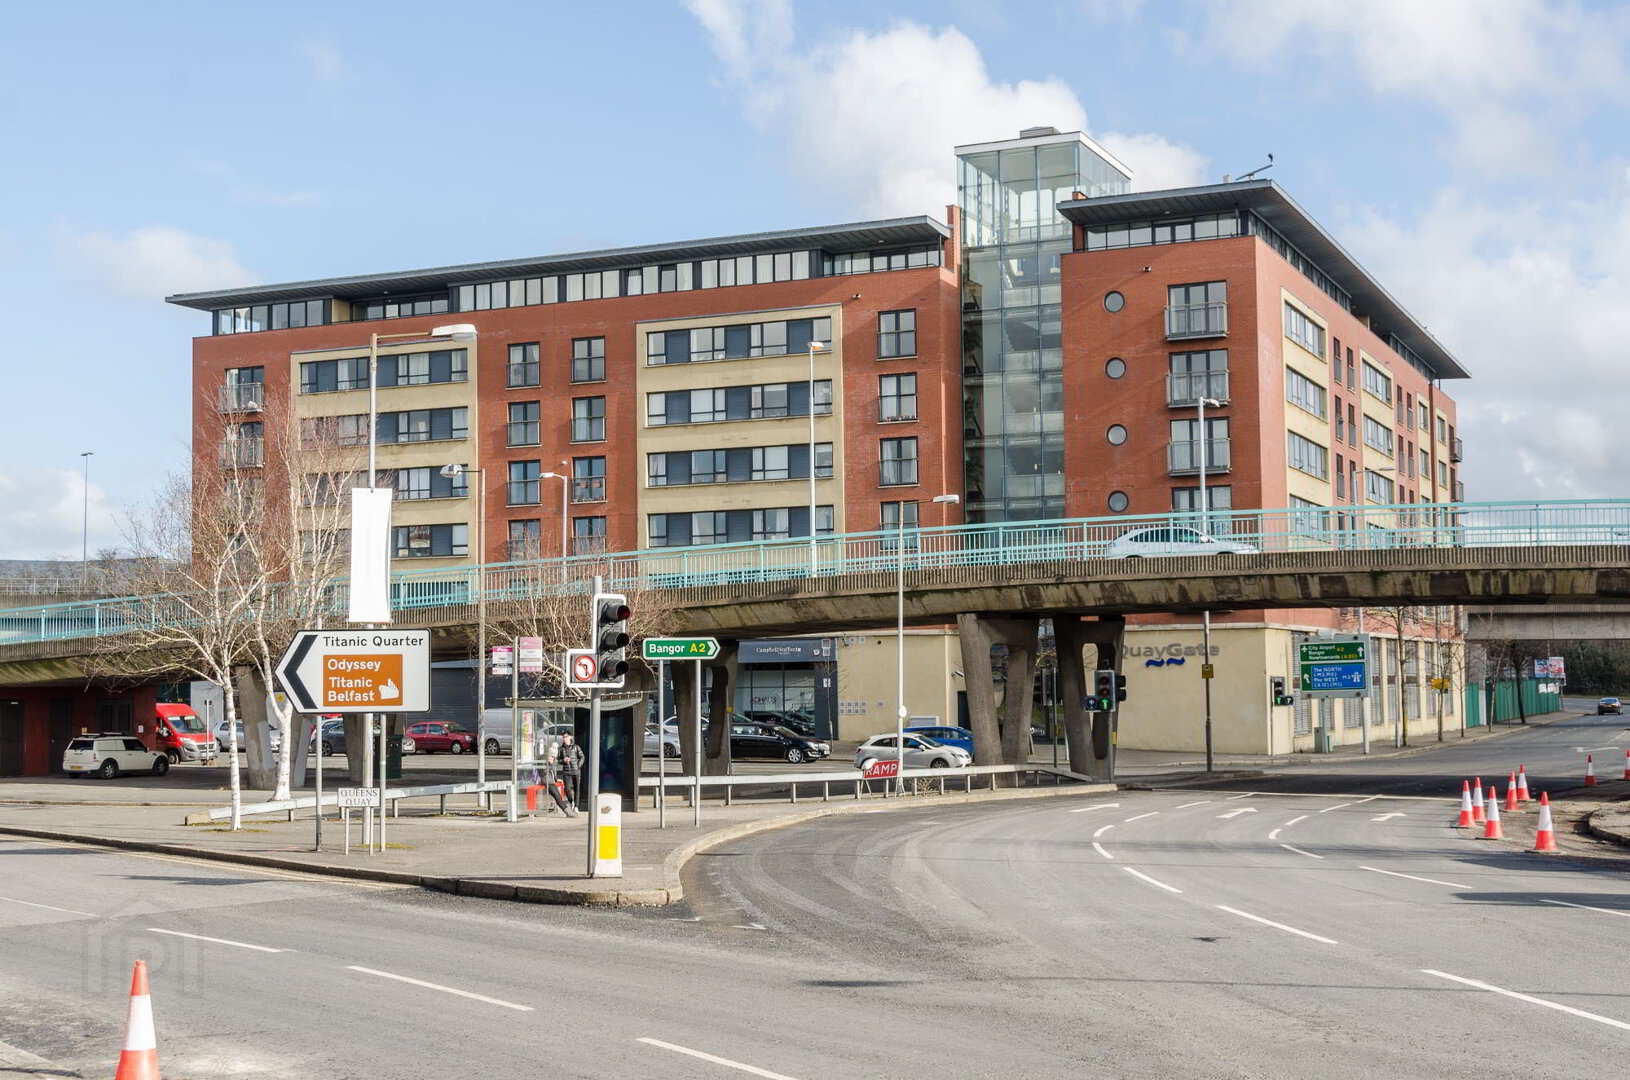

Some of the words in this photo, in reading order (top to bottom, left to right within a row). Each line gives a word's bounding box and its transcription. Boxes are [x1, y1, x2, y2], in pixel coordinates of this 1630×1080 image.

[323, 636, 368, 647] Titanic
[372, 635, 424, 647] Quarter
[649, 643, 685, 655] Bangor
[690, 643, 706, 653] A2
[327, 658, 381, 672] Odyssey
[329, 676, 373, 688] Titanic
[327, 690, 375, 702] Belfast
[340, 789, 378, 797] QUEENS
[345, 798, 372, 806] QUAY
